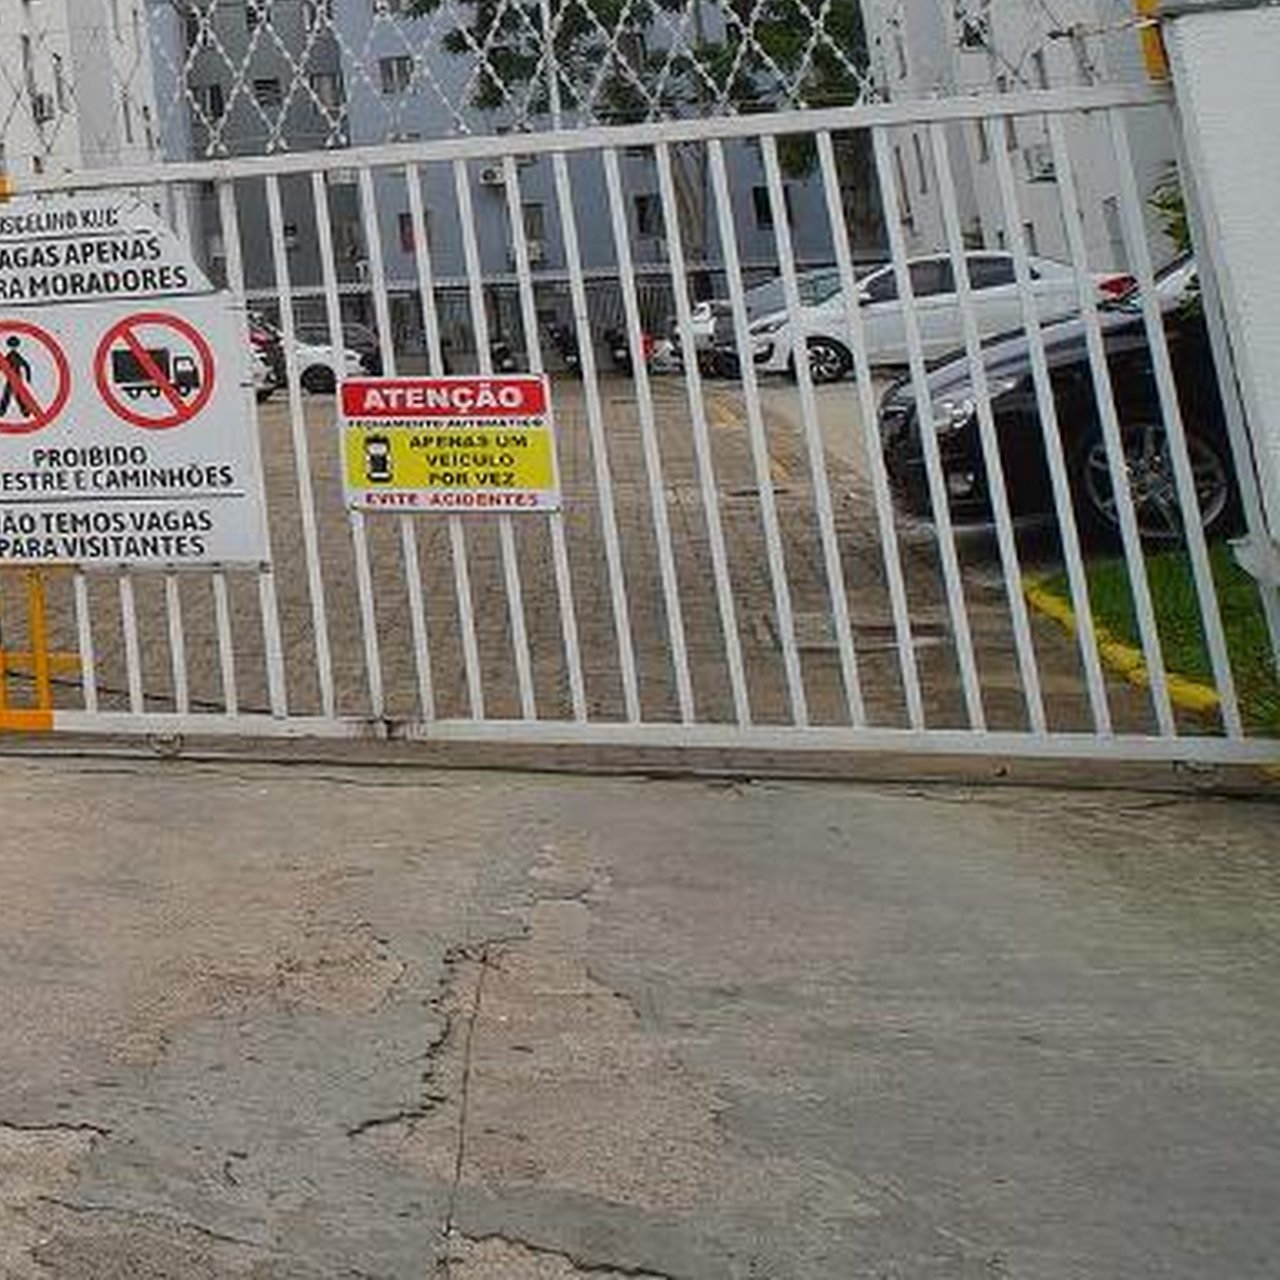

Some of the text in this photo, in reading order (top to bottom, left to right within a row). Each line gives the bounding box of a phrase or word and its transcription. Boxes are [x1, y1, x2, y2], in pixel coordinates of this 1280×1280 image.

[65, 237, 161, 264] APENAS
[28, 266, 188, 297] MORADORES
[363, 383, 524, 414] ATENÇÃO
[410, 435, 528, 448] APENAS UM
[33, 446, 148, 467] PROIBIDO
[74, 470, 86, 490] E
[92, 464, 234, 489] CAMINHÕES
[429, 473, 516, 486] POR VEZ
[366, 493, 539, 507] EVITE ACIDENTES
[41, 512, 126, 534] TEMOS
[129, 510, 213, 532] VAGAS
[62, 535, 205, 557] VISITANTES
